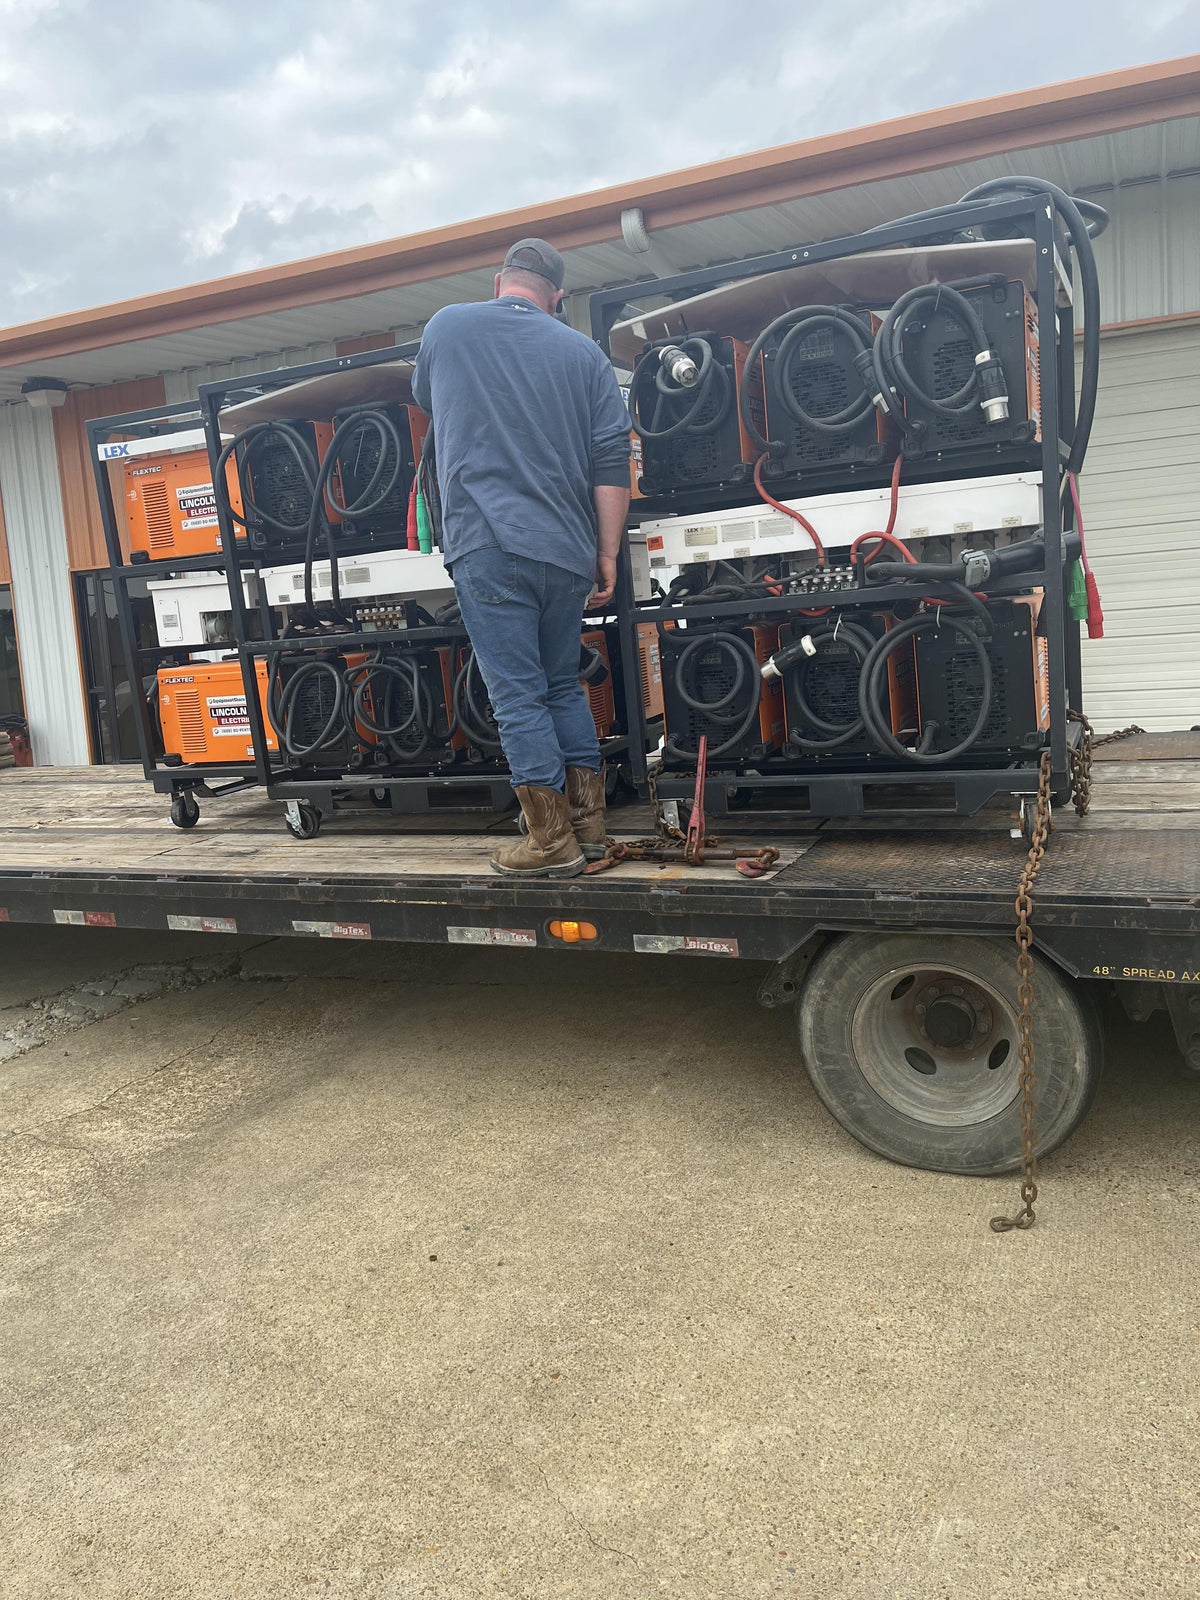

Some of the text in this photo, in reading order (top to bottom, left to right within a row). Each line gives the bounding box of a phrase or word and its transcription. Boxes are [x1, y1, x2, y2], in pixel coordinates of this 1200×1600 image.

[104, 444, 129, 458] LEX
[132, 466, 161, 476] FLEXTEC
[183, 486, 213, 495] EquipmentShar
[180, 496, 216, 509] LINCOLN
[190, 506, 218, 516] ELECTRI
[211, 707, 247, 717] LINCOLN
[1092, 966, 1116, 975] 48"
[1122, 967, 1176, 980] SPREAD
